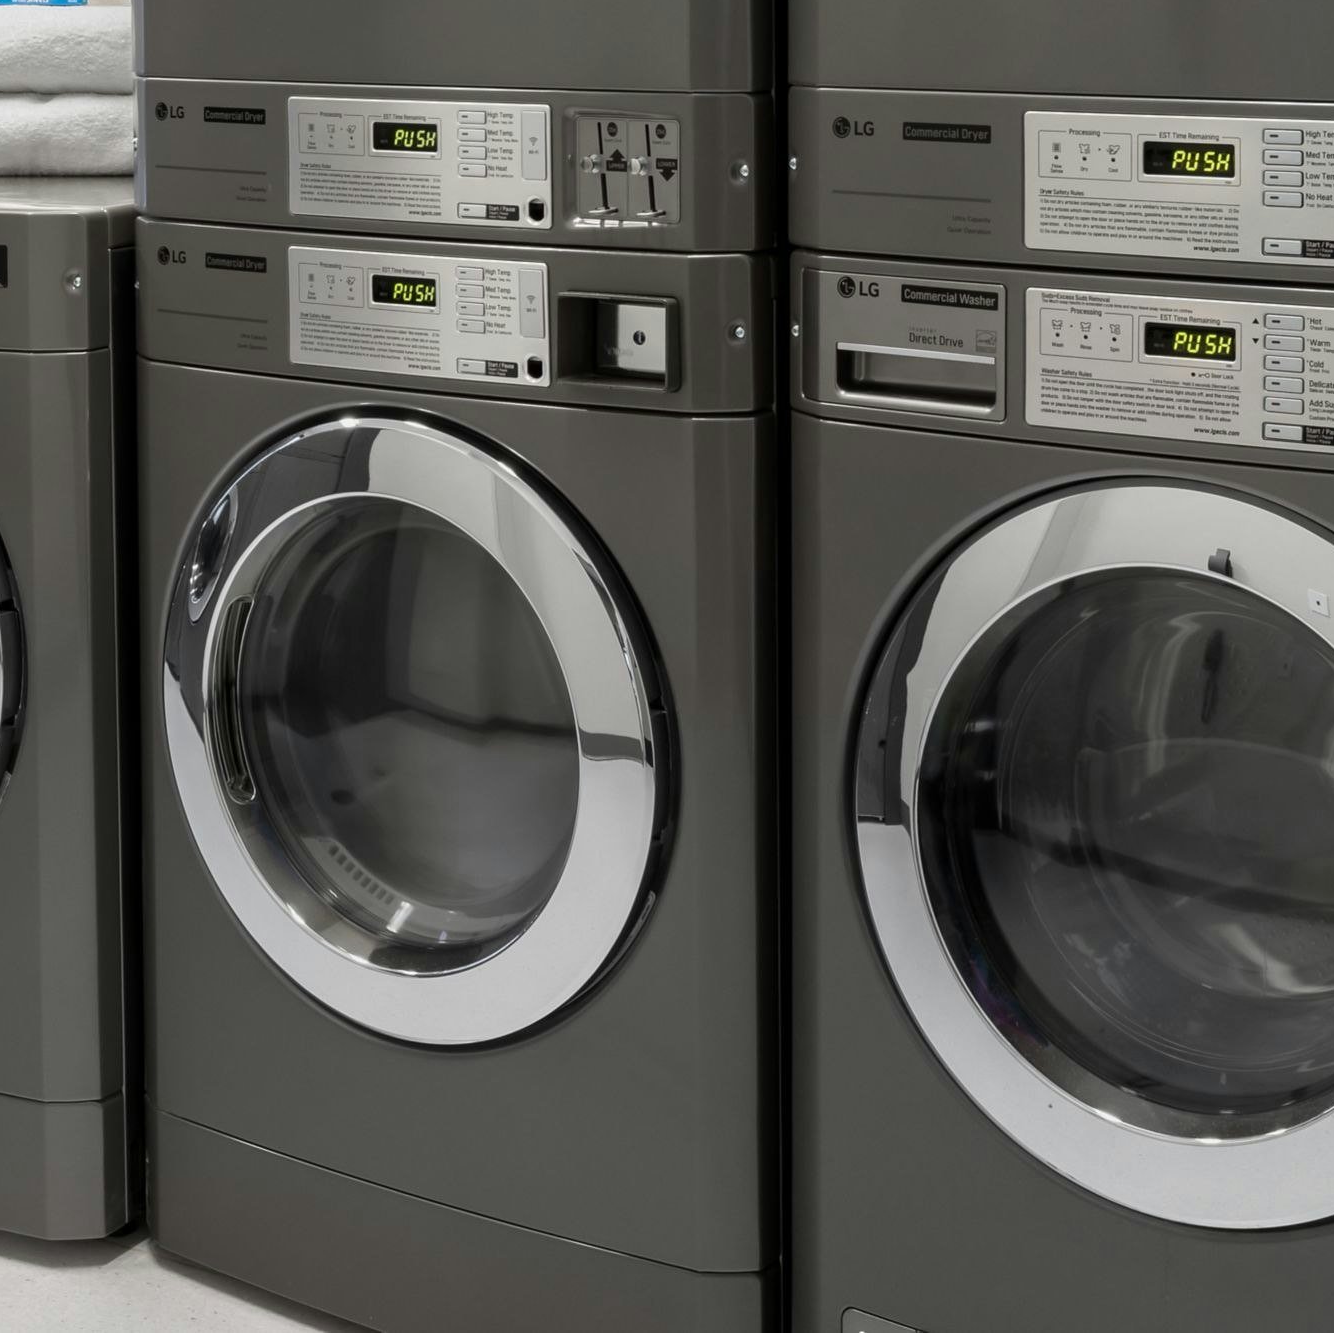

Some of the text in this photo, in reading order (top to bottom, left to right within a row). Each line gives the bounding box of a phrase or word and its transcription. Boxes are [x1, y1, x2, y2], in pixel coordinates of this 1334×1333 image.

[170, 106, 184, 118] LG
[245, 112, 264, 122] Dryer
[854, 121, 874, 136] LG
[905, 126, 989, 142] Commercial Dryer
[1069, 129, 1100, 137] Processing
[1305, 130, 1321, 138] High
[394, 129, 436, 147] PUSH
[1188, 133, 1219, 141] Remaining
[1172, 151, 1230, 171] PUSH
[173, 250, 186, 264] LG
[394, 283, 435, 302] PUSH
[860, 282, 879, 297] LG
[904, 288, 995, 306] Commercial Washer
[1071, 307, 1102, 316] Processing
[1189, 316, 1220, 325] Remaining
[909, 333, 936, 346] Direct
[939, 335, 963, 348] Drive
[1173, 332, 1232, 354] PUSH
[1310, 339, 1330, 347] Warm
[1309, 400, 1324, 408] Add
